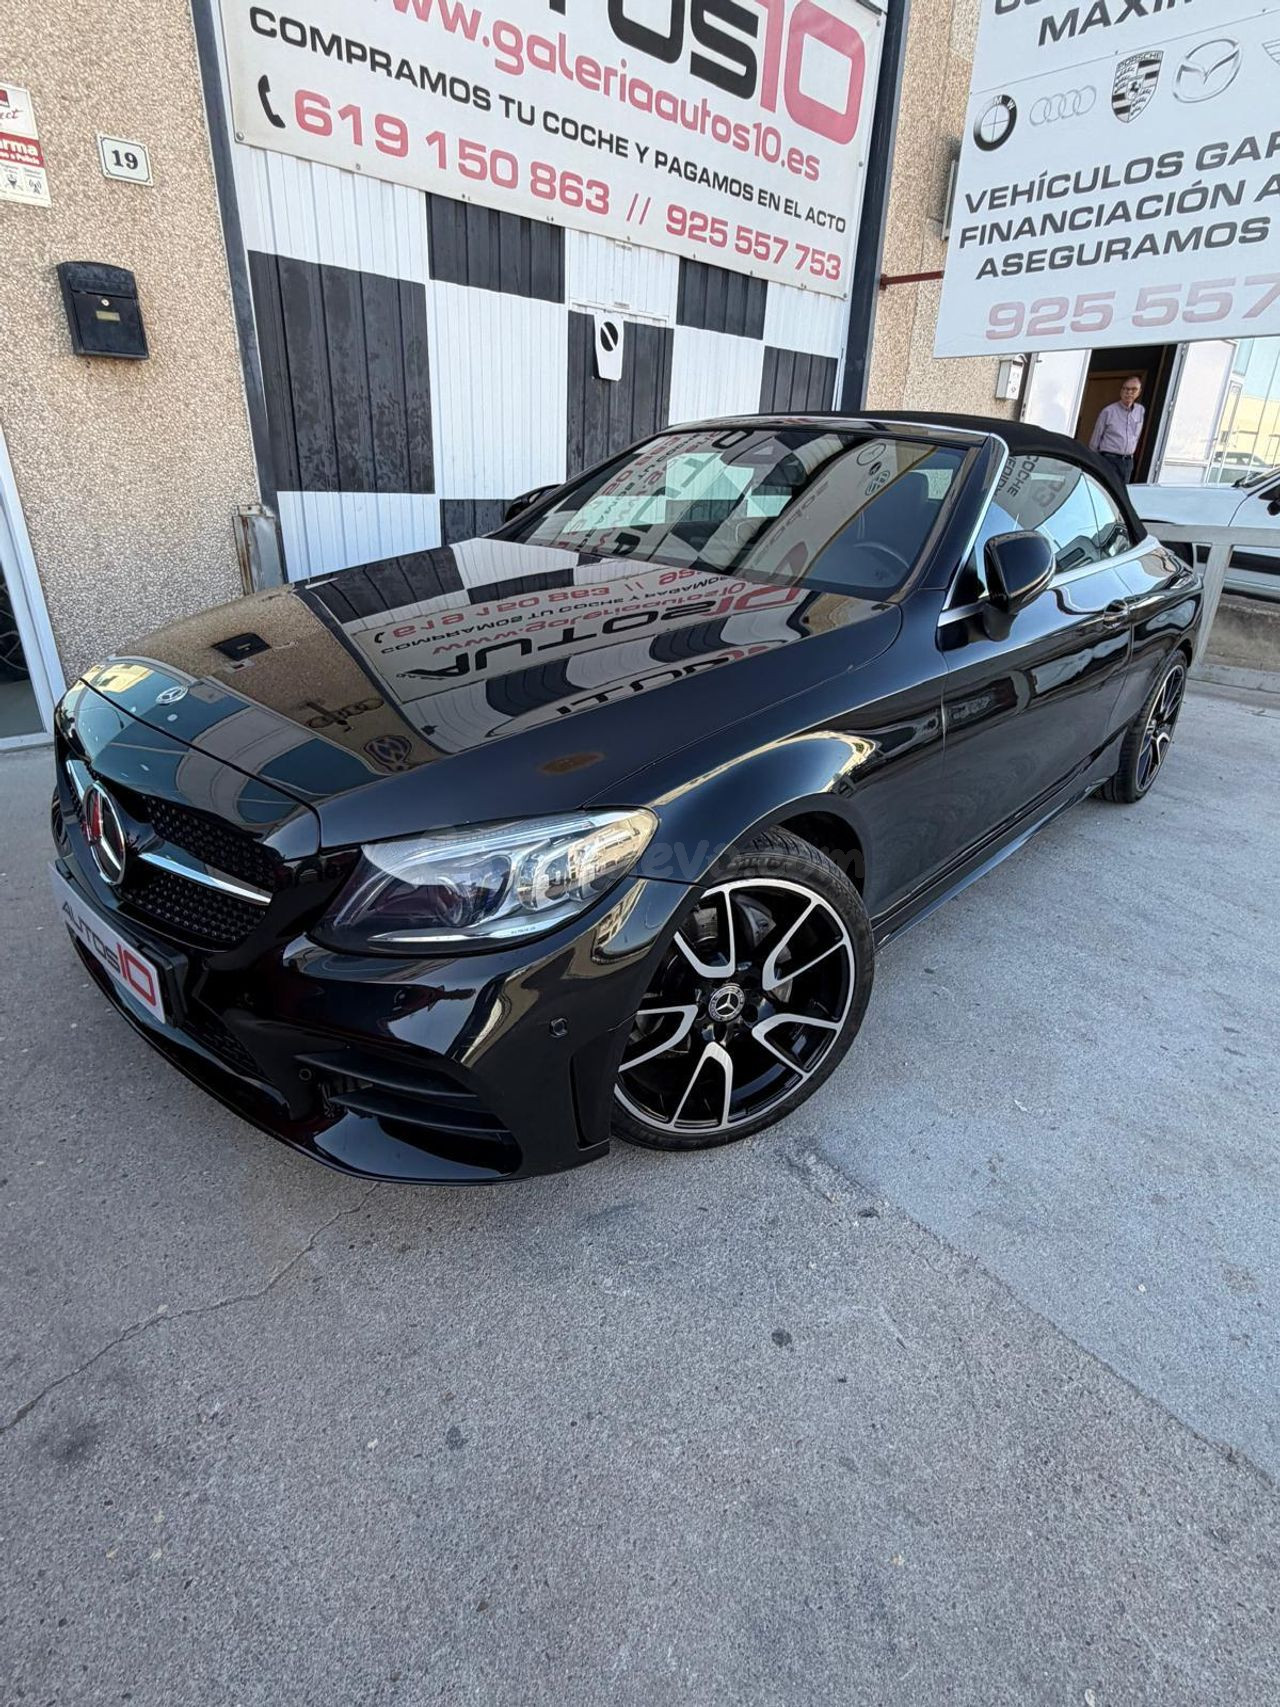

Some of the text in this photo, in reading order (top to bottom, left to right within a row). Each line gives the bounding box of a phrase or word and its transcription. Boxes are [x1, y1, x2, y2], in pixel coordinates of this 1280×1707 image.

[374, 0, 820, 181] ww.galeriaautos10.es
[549, 0, 866, 145] OS10
[250, 6, 846, 234] COMPRAMOS TU COCHE Y PAGAMOS EN EL ACTO
[112, 150, 138, 170] 19
[294, 89, 409, 158] 619
[425, 130, 519, 190] 150
[530, 161, 610, 215] 863
[666, 204, 728, 248] 925
[735, 225, 788, 264] 557
[795, 243, 841, 281] 753
[965, 151, 1183, 214] VEHÍCULOS
[959, 179, 1246, 249] FINANCIACIÓN
[975, 216, 1271, 280] ASEGURAMOS
[985, 272, 1280, 341] 925 557
